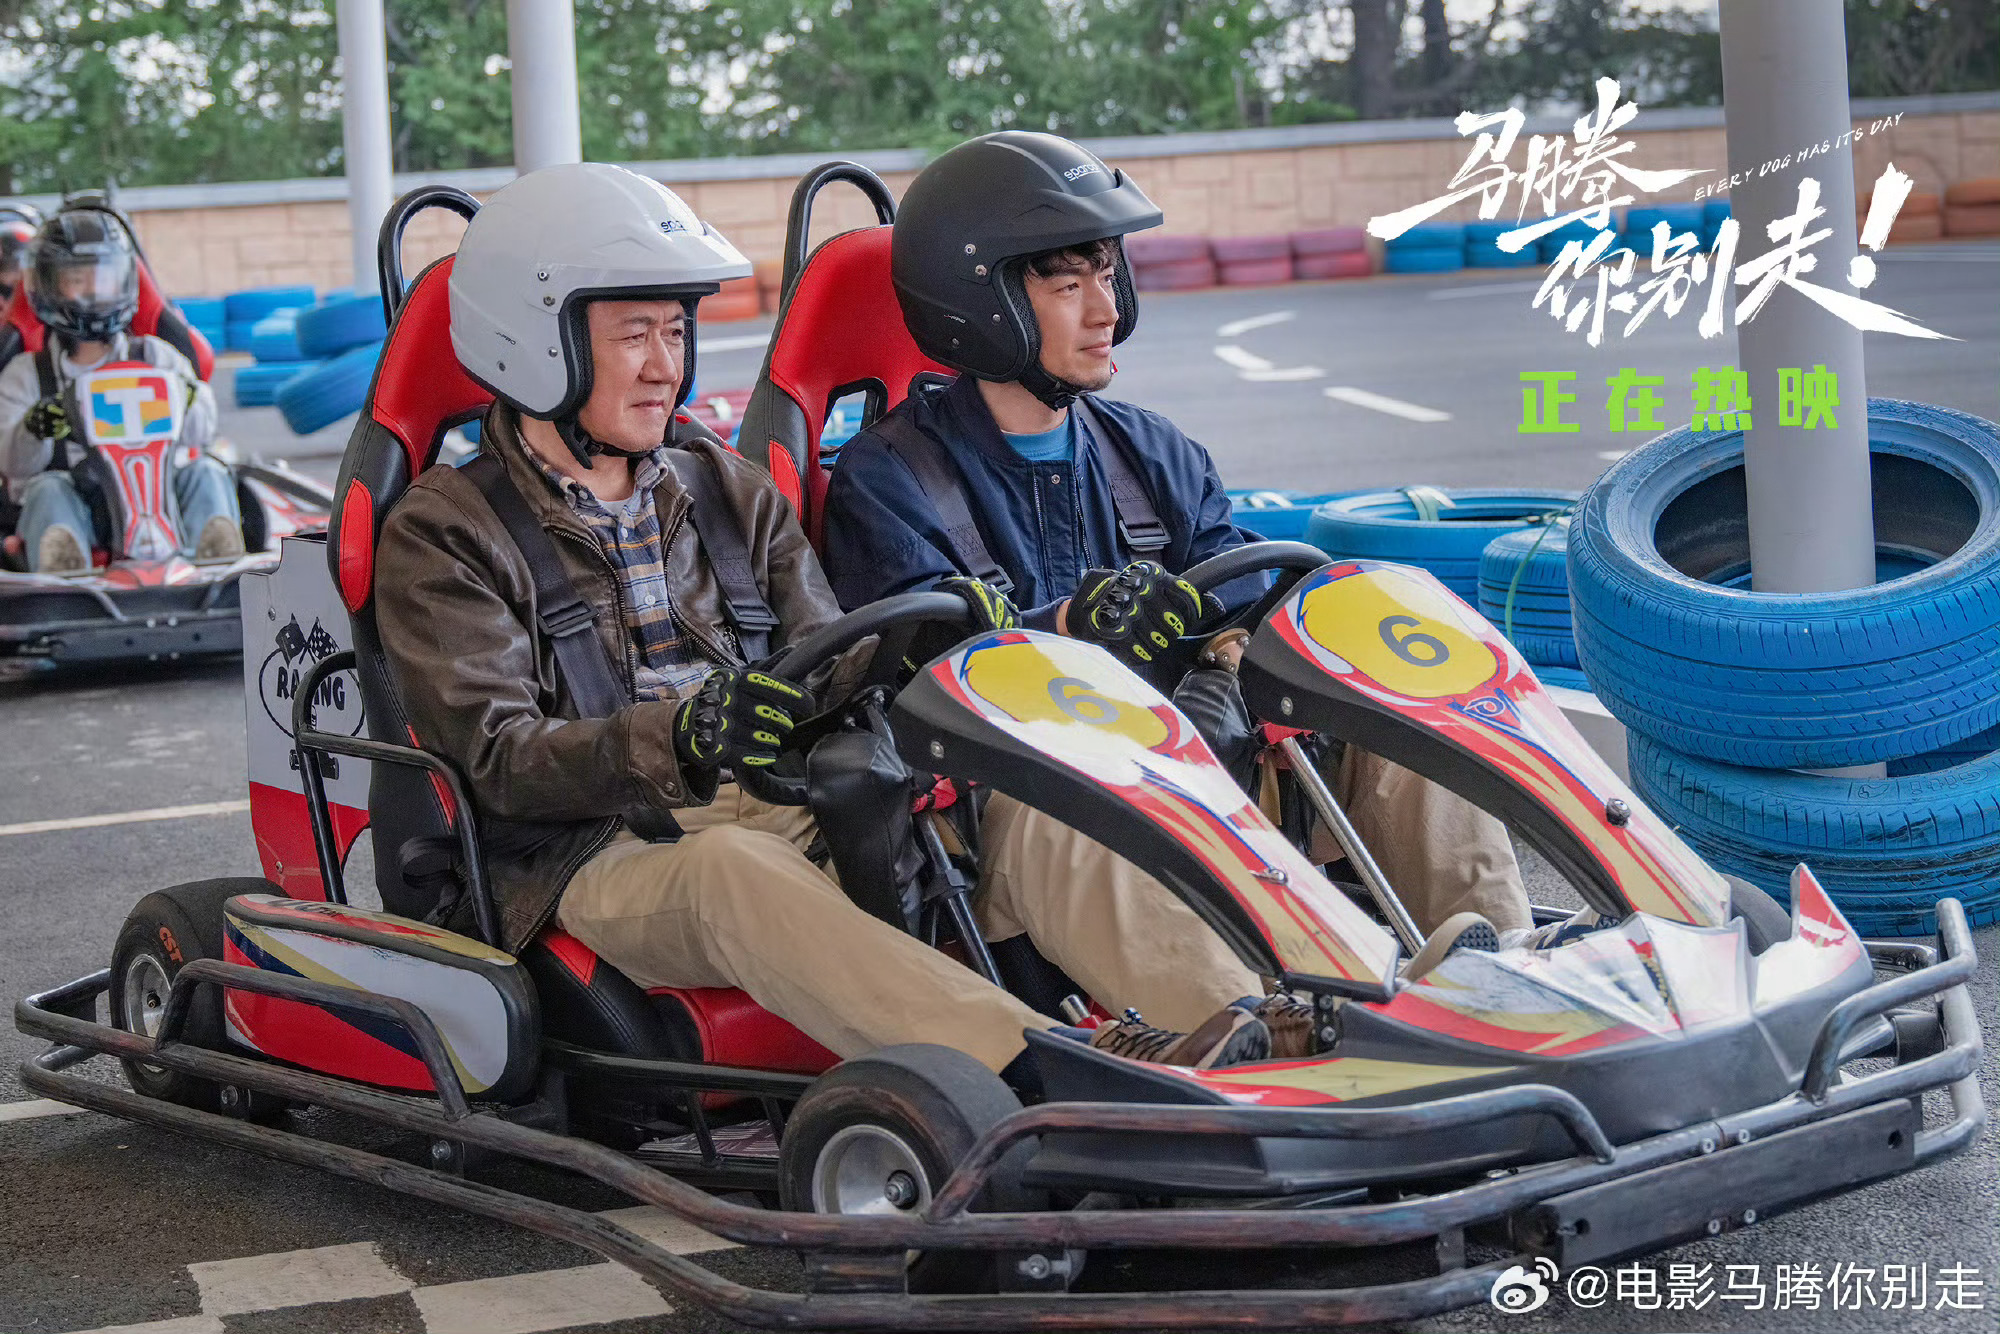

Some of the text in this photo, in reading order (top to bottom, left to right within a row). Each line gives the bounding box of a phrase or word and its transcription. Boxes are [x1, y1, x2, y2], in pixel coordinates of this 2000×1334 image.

[1378, 615, 1451, 668] 6
[1047, 677, 1120, 725] 6
[160, 927, 183, 963] CST
